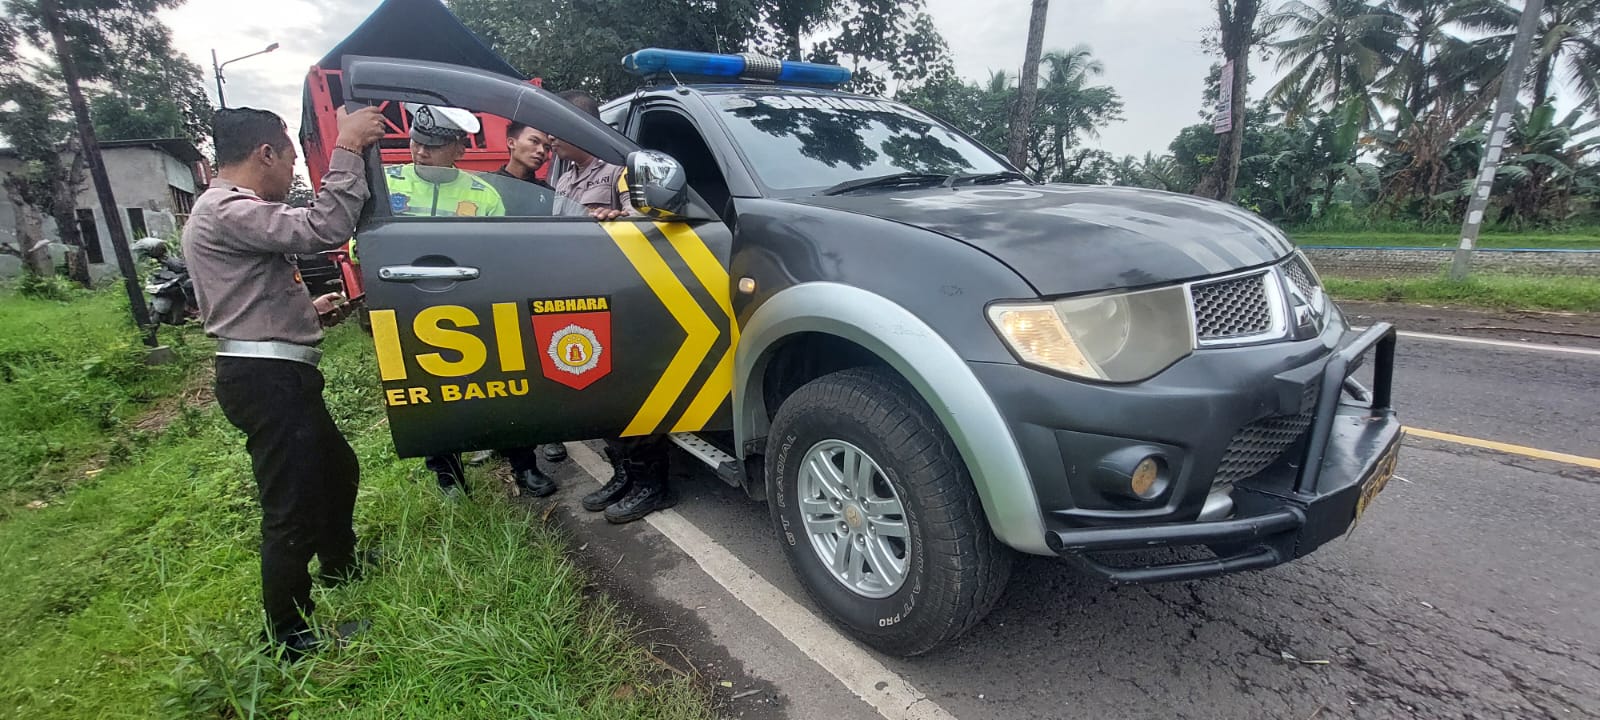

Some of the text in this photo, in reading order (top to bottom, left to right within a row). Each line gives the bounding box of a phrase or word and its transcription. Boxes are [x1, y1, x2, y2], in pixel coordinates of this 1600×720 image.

[533, 297, 608, 313] SABHARA
[440, 378, 530, 402] BARU
[775, 435, 797, 546] GT RADIAL
[878, 612, 901, 627] PRO
